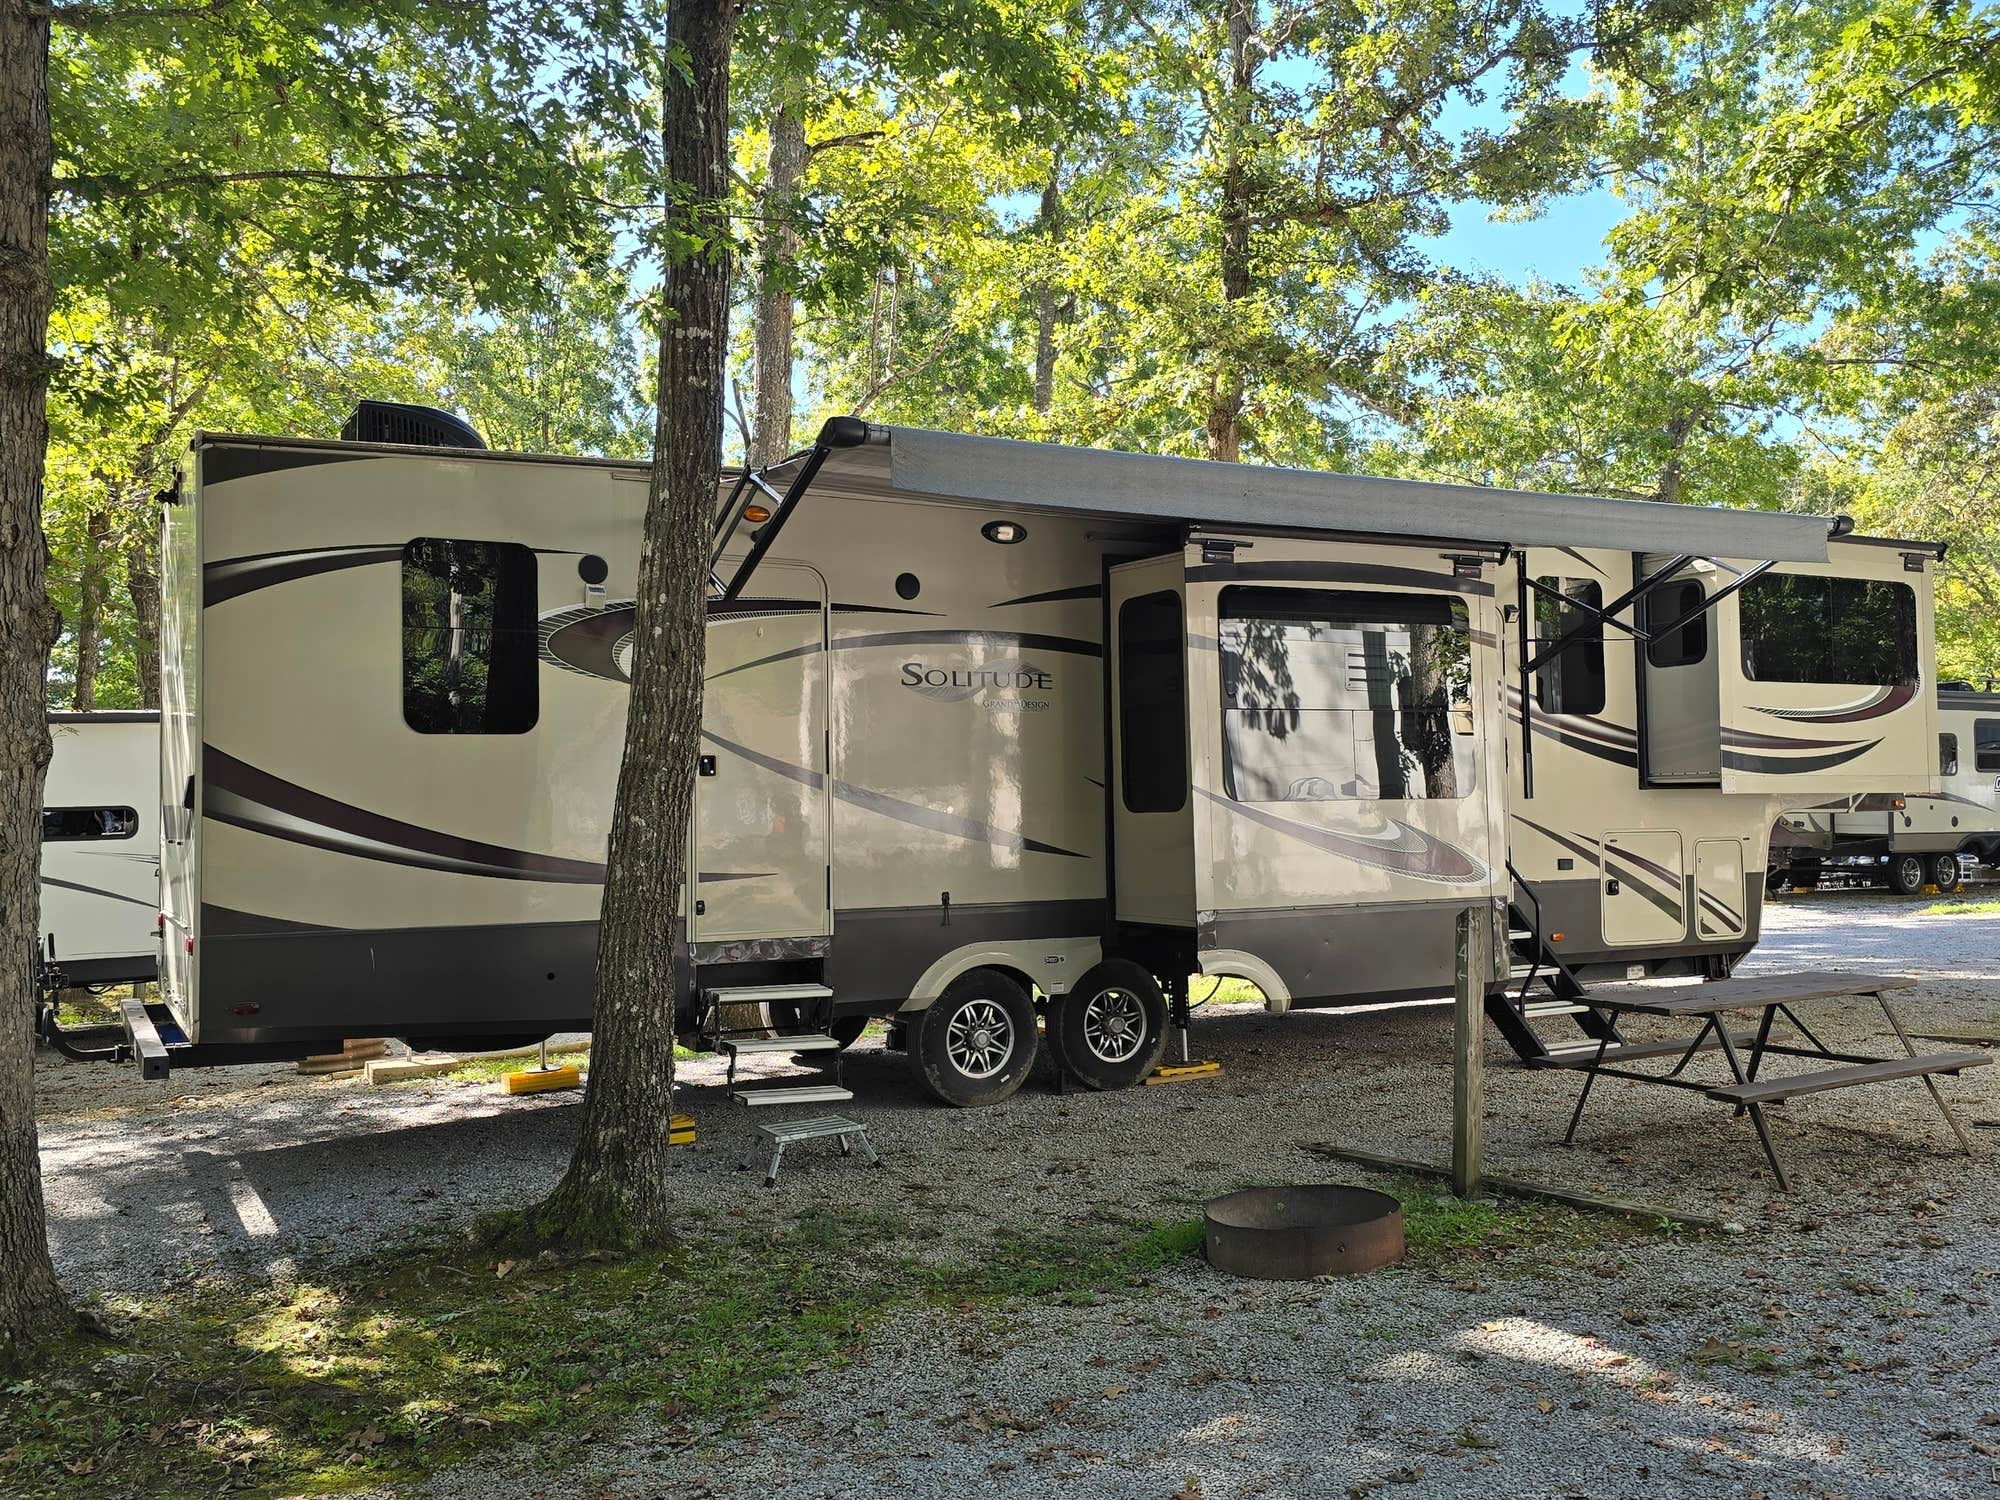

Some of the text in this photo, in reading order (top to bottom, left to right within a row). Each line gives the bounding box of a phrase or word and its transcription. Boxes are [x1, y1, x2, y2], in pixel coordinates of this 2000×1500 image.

[901, 663, 1053, 689] SOLITUDE
[1021, 700, 1050, 710] DESIGN
[1457, 943, 1467, 962] 4
